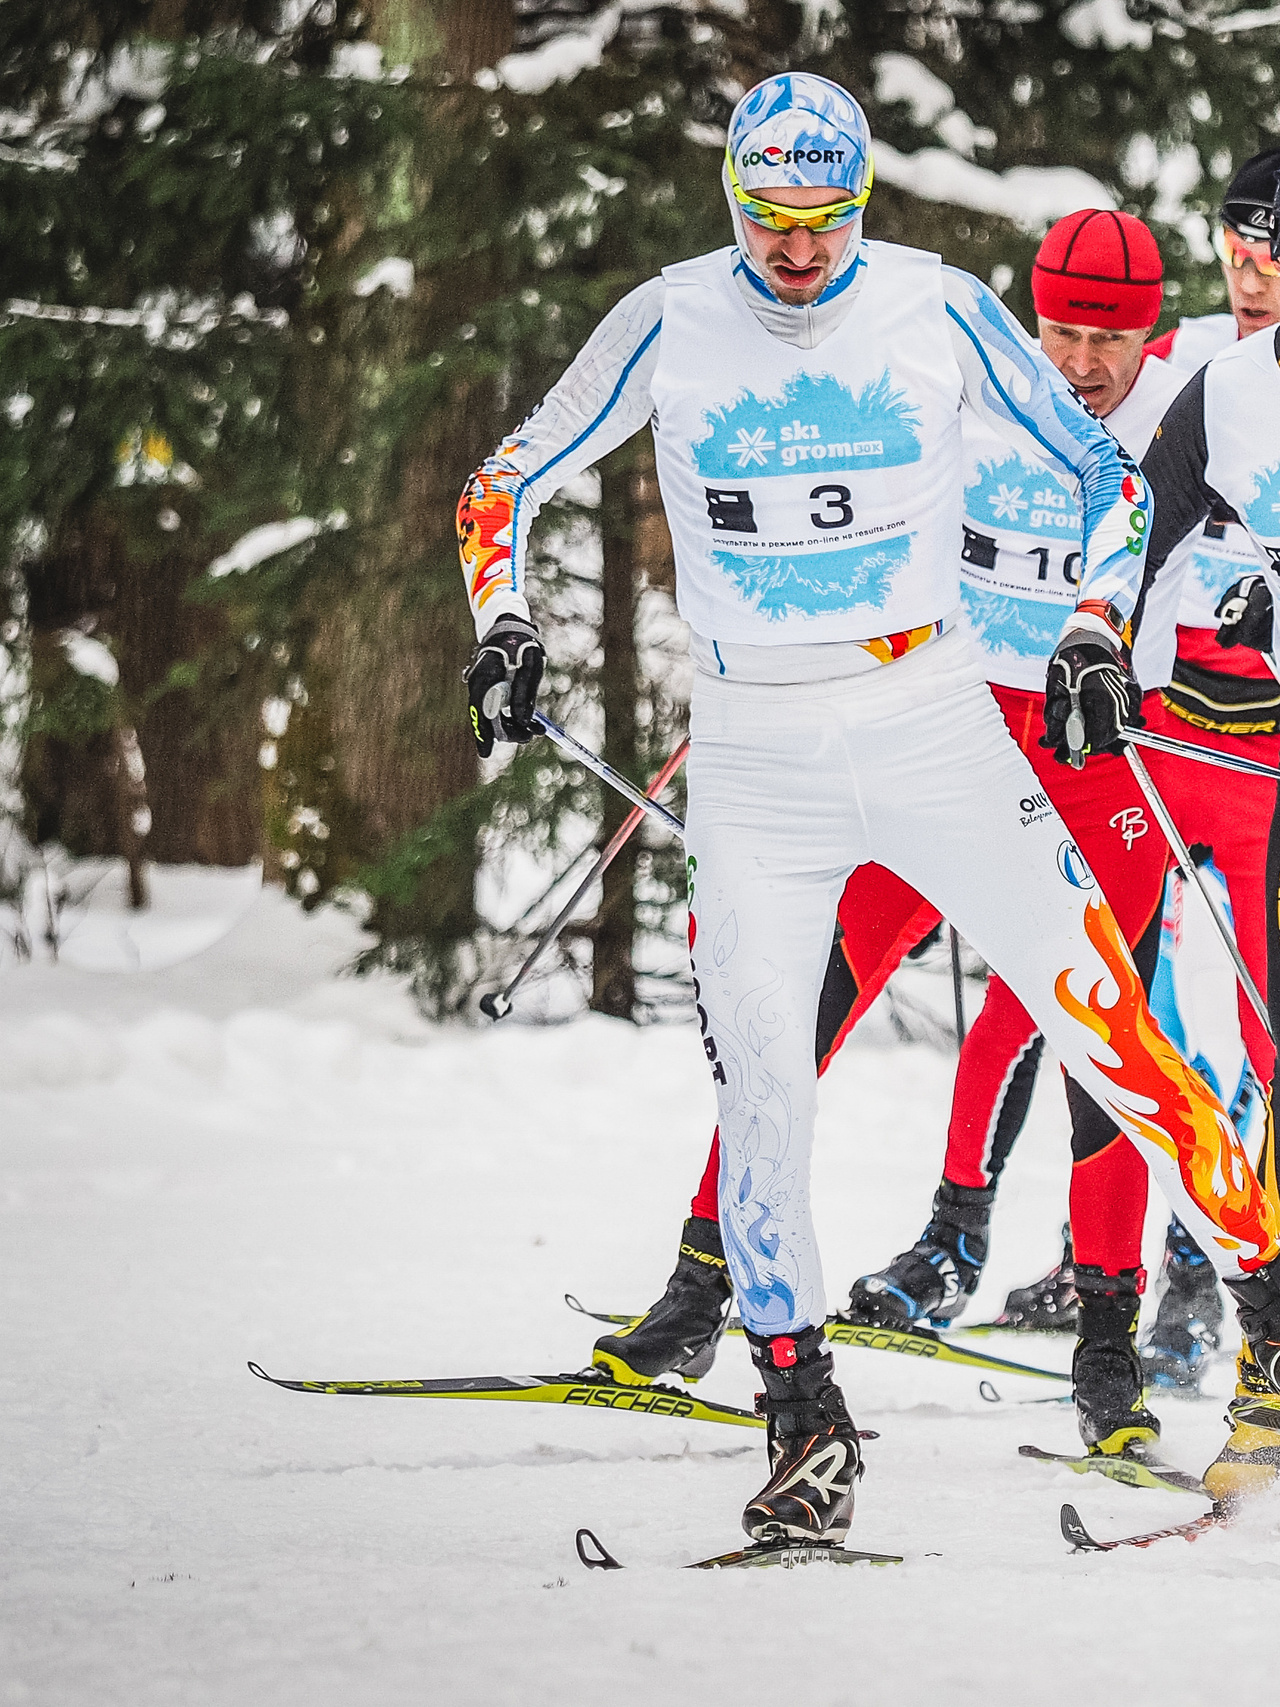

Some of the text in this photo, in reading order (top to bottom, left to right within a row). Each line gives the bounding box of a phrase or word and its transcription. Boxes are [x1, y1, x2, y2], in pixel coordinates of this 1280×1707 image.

[783, 149, 845, 165] SPORT
[780, 420, 821, 441] ski
[781, 442, 853, 467] grom
[809, 484, 854, 530] 3
[807, 535, 840, 546] on-line
[855, 519, 906, 538] results.zone
[828, 1328, 939, 1358] FISCHER
[563, 1387, 695, 1418] FISCHER
